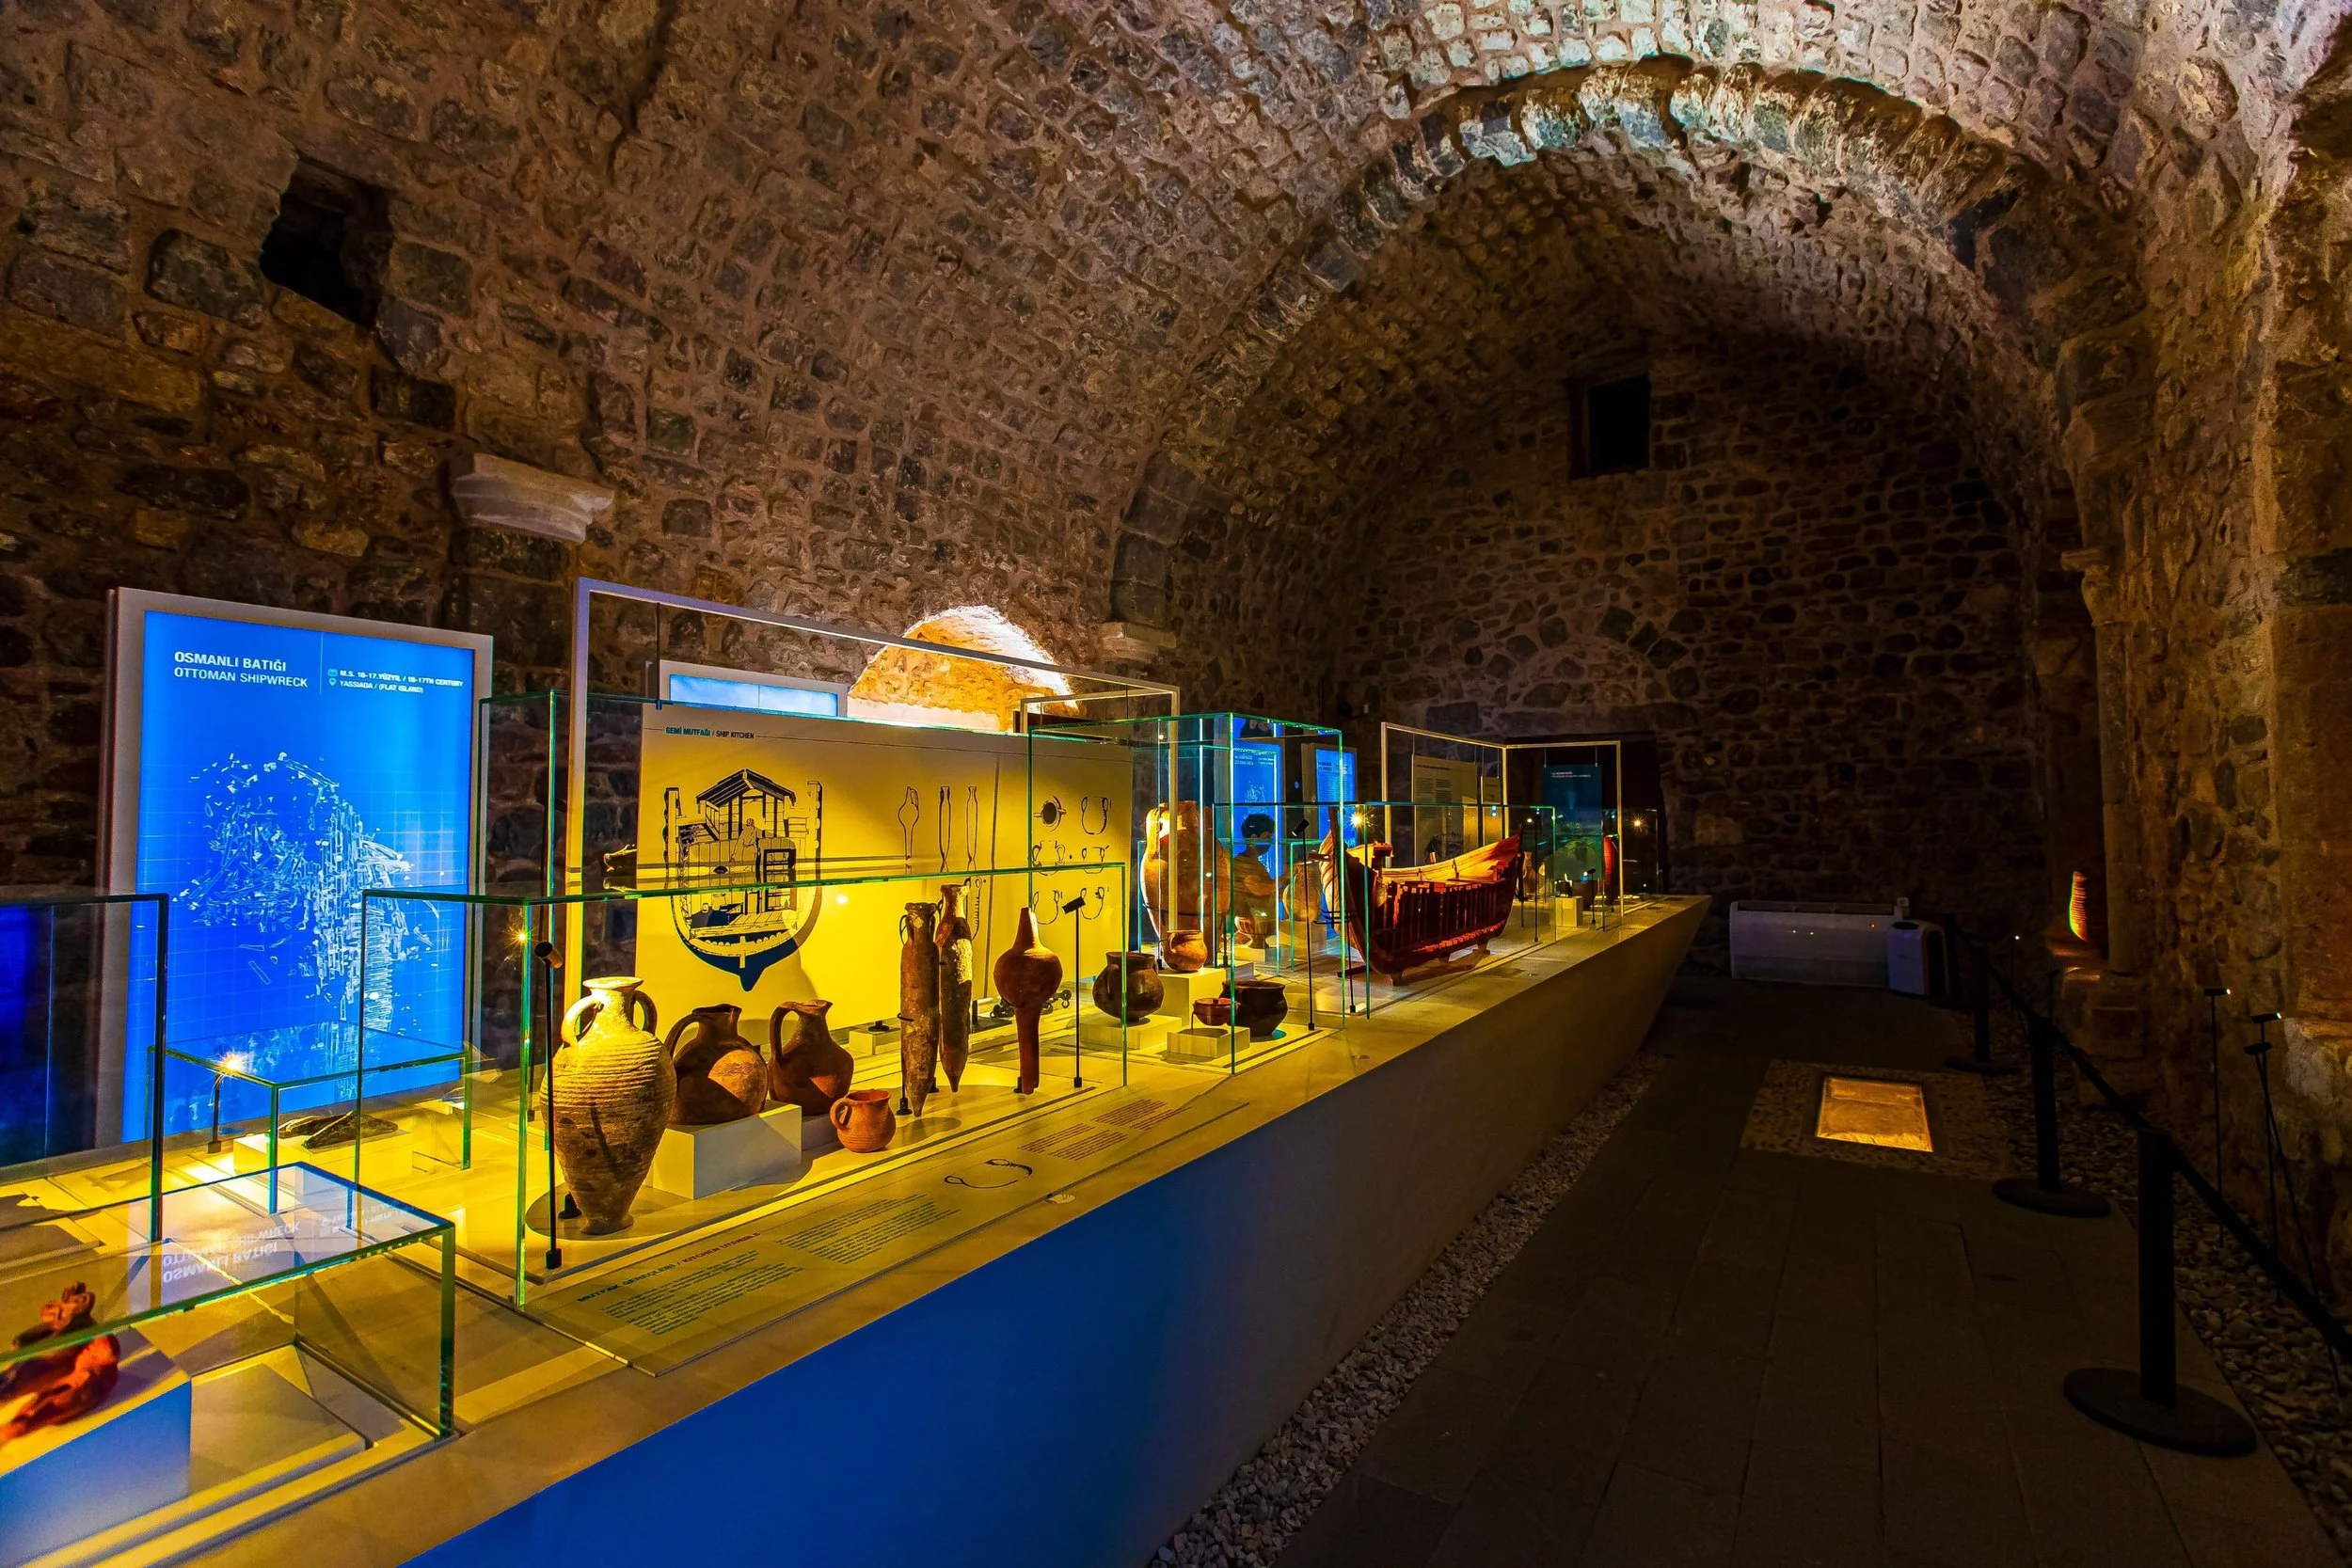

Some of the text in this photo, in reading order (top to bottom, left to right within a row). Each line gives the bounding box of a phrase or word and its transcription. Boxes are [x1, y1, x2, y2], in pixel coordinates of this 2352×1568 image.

[174, 651, 286, 672] OSMANLI BATIĞI
[173, 667, 309, 688] OTTOMAN SHIPWRECK
[340, 680, 373, 689] YASSIADA
[665, 726, 682, 735] GEMİ
[683, 728, 711, 736] MUTFAĞI
[730, 731, 755, 739] KITCHEN
